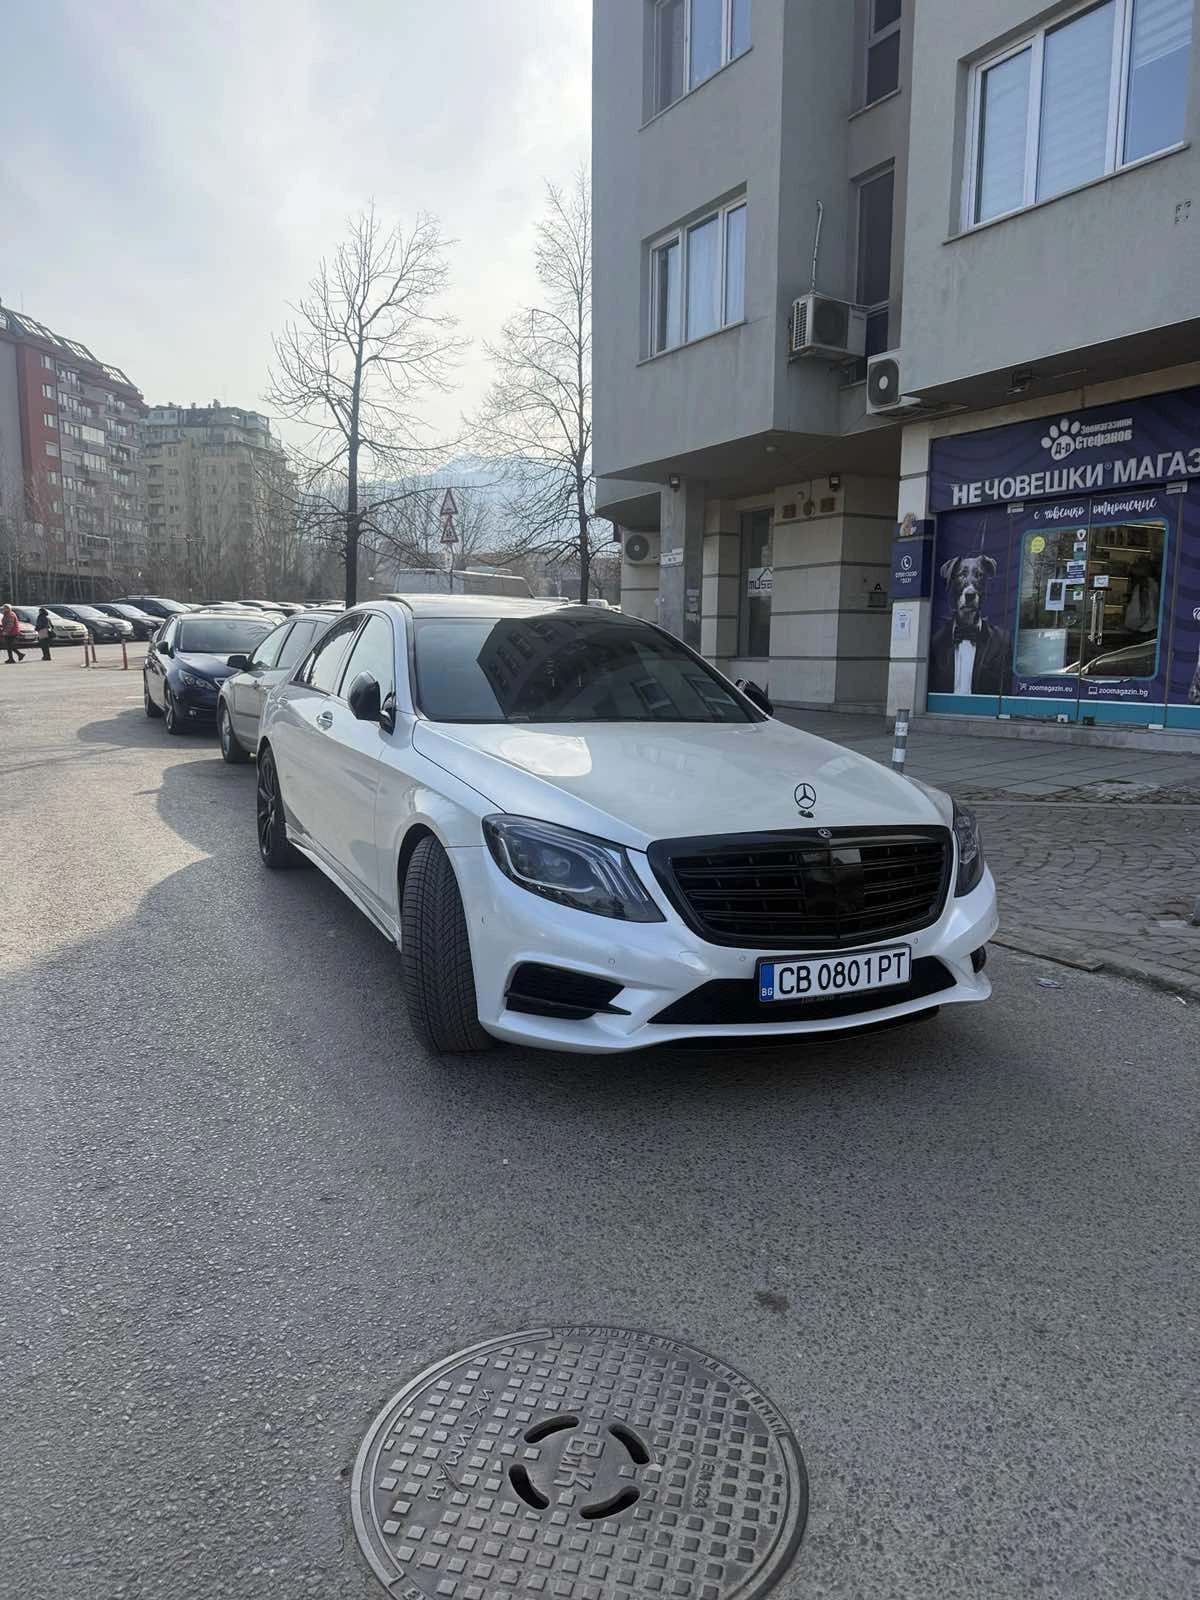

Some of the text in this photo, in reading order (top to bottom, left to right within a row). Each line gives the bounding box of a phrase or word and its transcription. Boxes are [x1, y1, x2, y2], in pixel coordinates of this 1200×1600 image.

[1075, 429, 1133, 450] Стефанов
[1093, 497, 1158, 516] отношение
[1028, 684, 1073, 693] zoomagazin.eu
[1098, 687, 1149, 698] zoomagazin.bg
[778, 952, 906, 995] CB 0801 PT
[761, 987, 773, 997] BG
